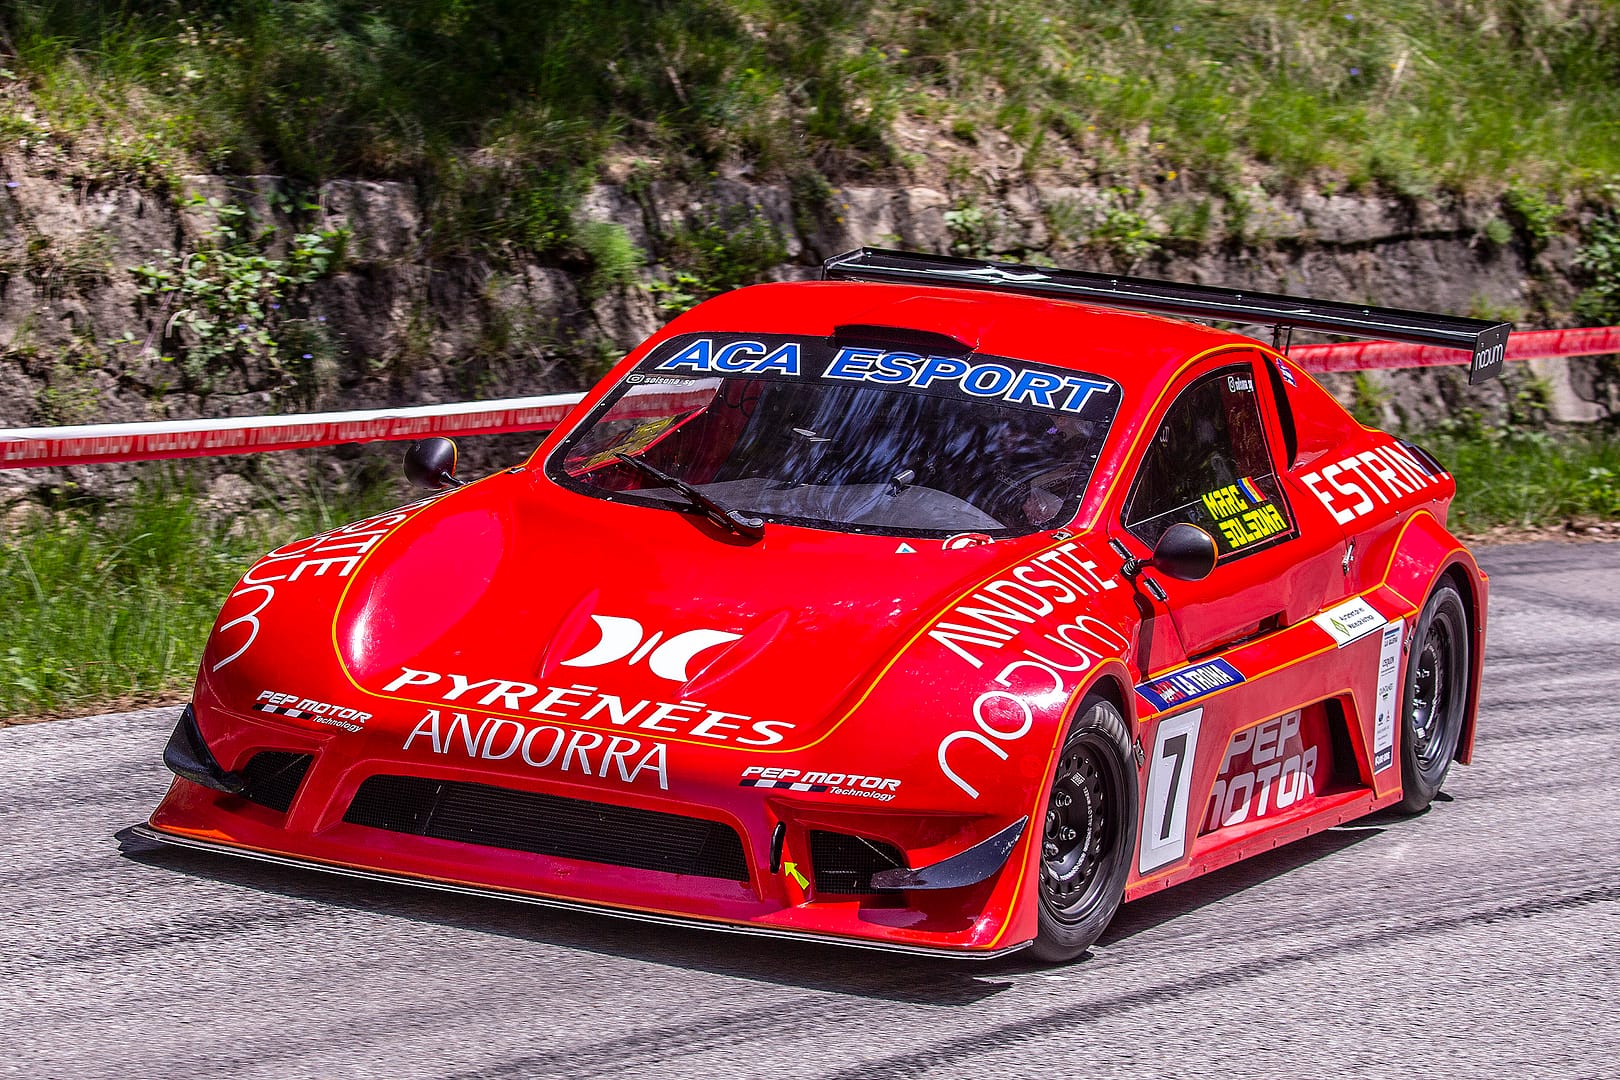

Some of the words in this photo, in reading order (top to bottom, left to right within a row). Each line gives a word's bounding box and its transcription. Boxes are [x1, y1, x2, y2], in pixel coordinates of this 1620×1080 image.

[654, 338, 801, 376] ACA
[821, 346, 1114, 414] ESPORT
[1201, 484, 1249, 521] MARC
[1218, 503, 1288, 549] SOLSONA
[1169, 675, 1201, 696] LA
[256, 690, 299, 705] PEP
[295, 699, 373, 724] MOTOR
[313, 715, 364, 733] Technology
[403, 709, 669, 790] ANDORRA
[1218, 708, 1302, 775] PEP
[741, 766, 800, 779] PEP
[800, 771, 902, 791] MOTOR
[829, 786, 896, 802] Technology
[1160, 732, 1189, 841] 7
